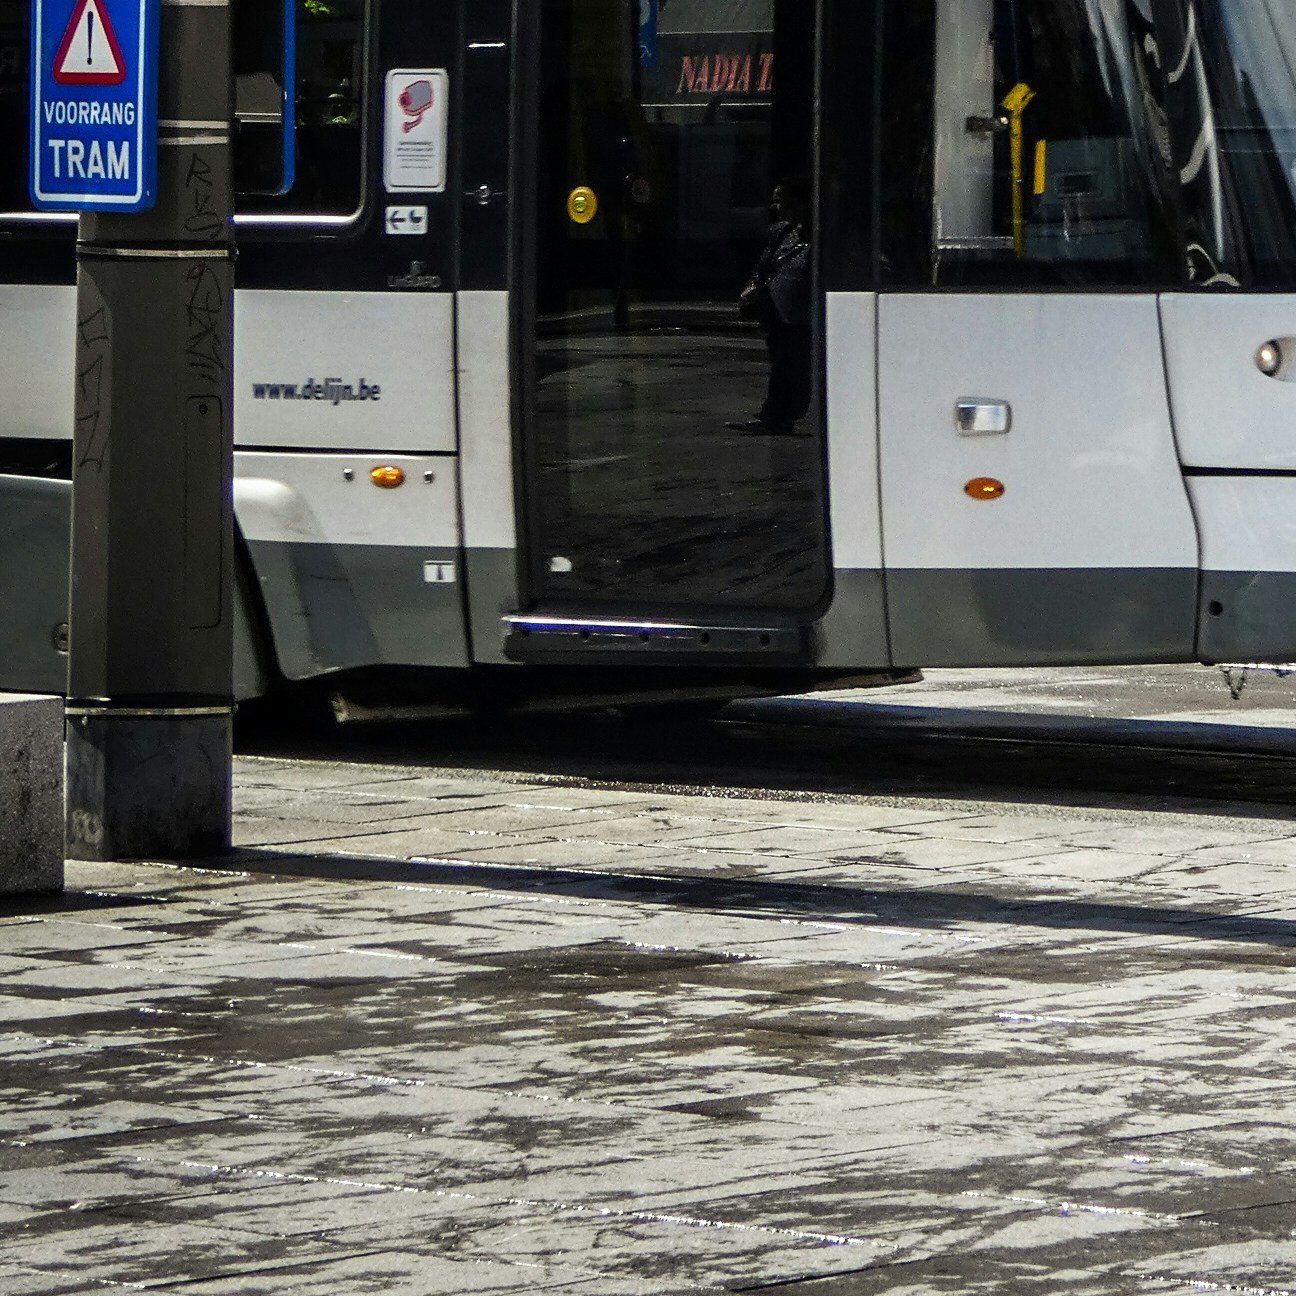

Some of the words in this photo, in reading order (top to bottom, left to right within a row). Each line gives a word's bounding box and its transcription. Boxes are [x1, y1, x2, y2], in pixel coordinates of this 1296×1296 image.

[676, 55, 751, 94] NADIA
[44, 101, 135, 125] VOORRANG
[48, 139, 130, 180] TRAM
[252, 377, 382, 406] www.delijn.be
